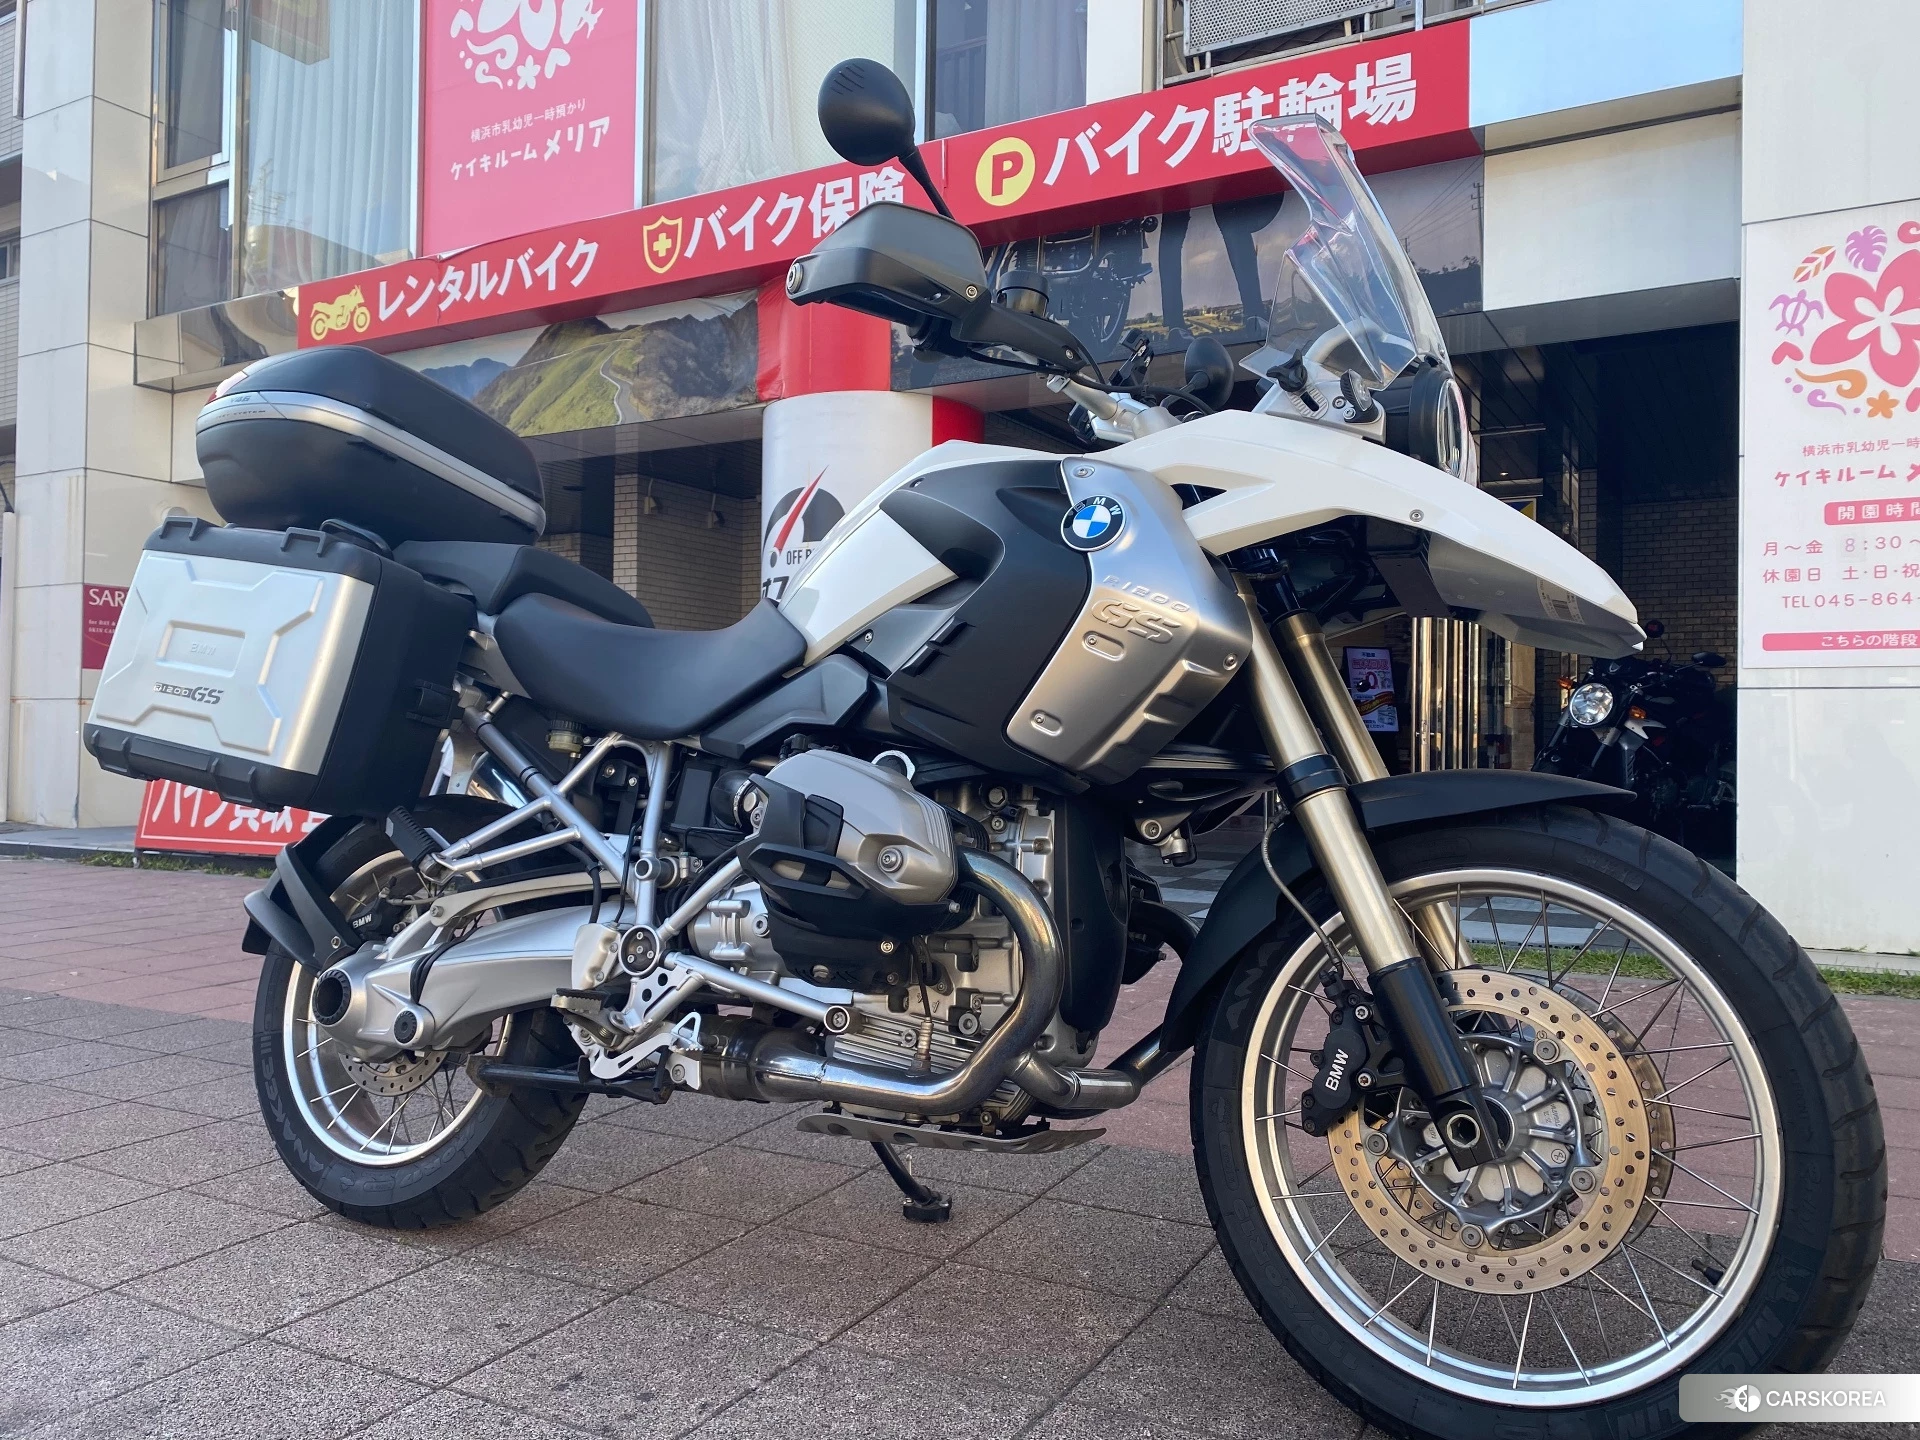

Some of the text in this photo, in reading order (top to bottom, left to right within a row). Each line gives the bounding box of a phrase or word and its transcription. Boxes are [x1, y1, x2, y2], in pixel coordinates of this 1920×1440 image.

[470, 98, 586, 143] 横浜市乳幼児一時預かり
[1042, 52, 1418, 186] バイク駐輪場
[450, 116, 610, 181] ケイキルーム メリア
[378, 238, 600, 322] レンタルバイク
[1774, 464, 1897, 487] ケイキルーム
[1074, 496, 1122, 516] BMW
[786, 549, 803, 565] OFF
[1762, 568, 1821, 584] 休園日
[88, 588, 127, 608] SAR
[1091, 598, 1182, 645] GS
[352, 913, 372, 929] BMW
[1325, 1049, 1350, 1092] BMW
